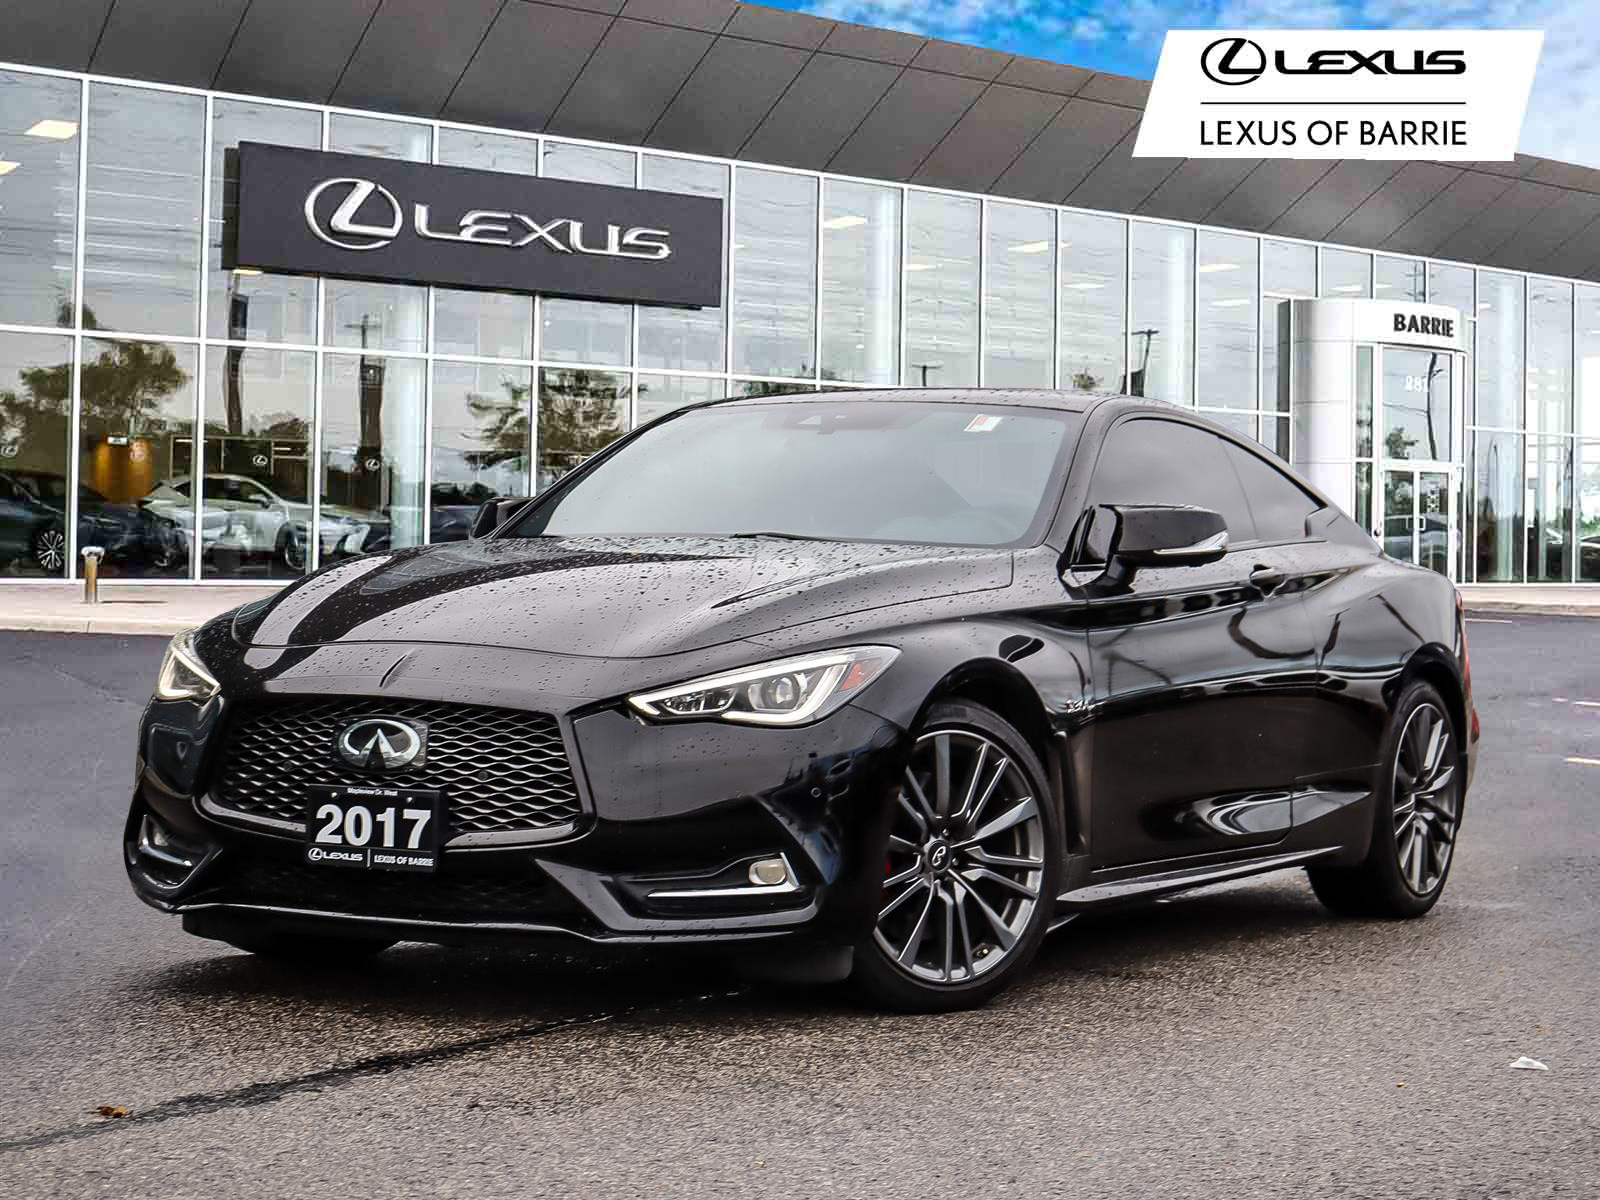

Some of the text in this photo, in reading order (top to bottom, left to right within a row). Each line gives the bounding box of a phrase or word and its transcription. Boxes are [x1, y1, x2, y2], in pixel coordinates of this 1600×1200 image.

[415, 202, 671, 260] LEXUS
[1393, 313, 1454, 338] BARRIE
[315, 803, 431, 849] 2017
[323, 851, 363, 861] LEXUS
[373, 854, 396, 864] LEXUS
[397, 855, 408, 865] OF
